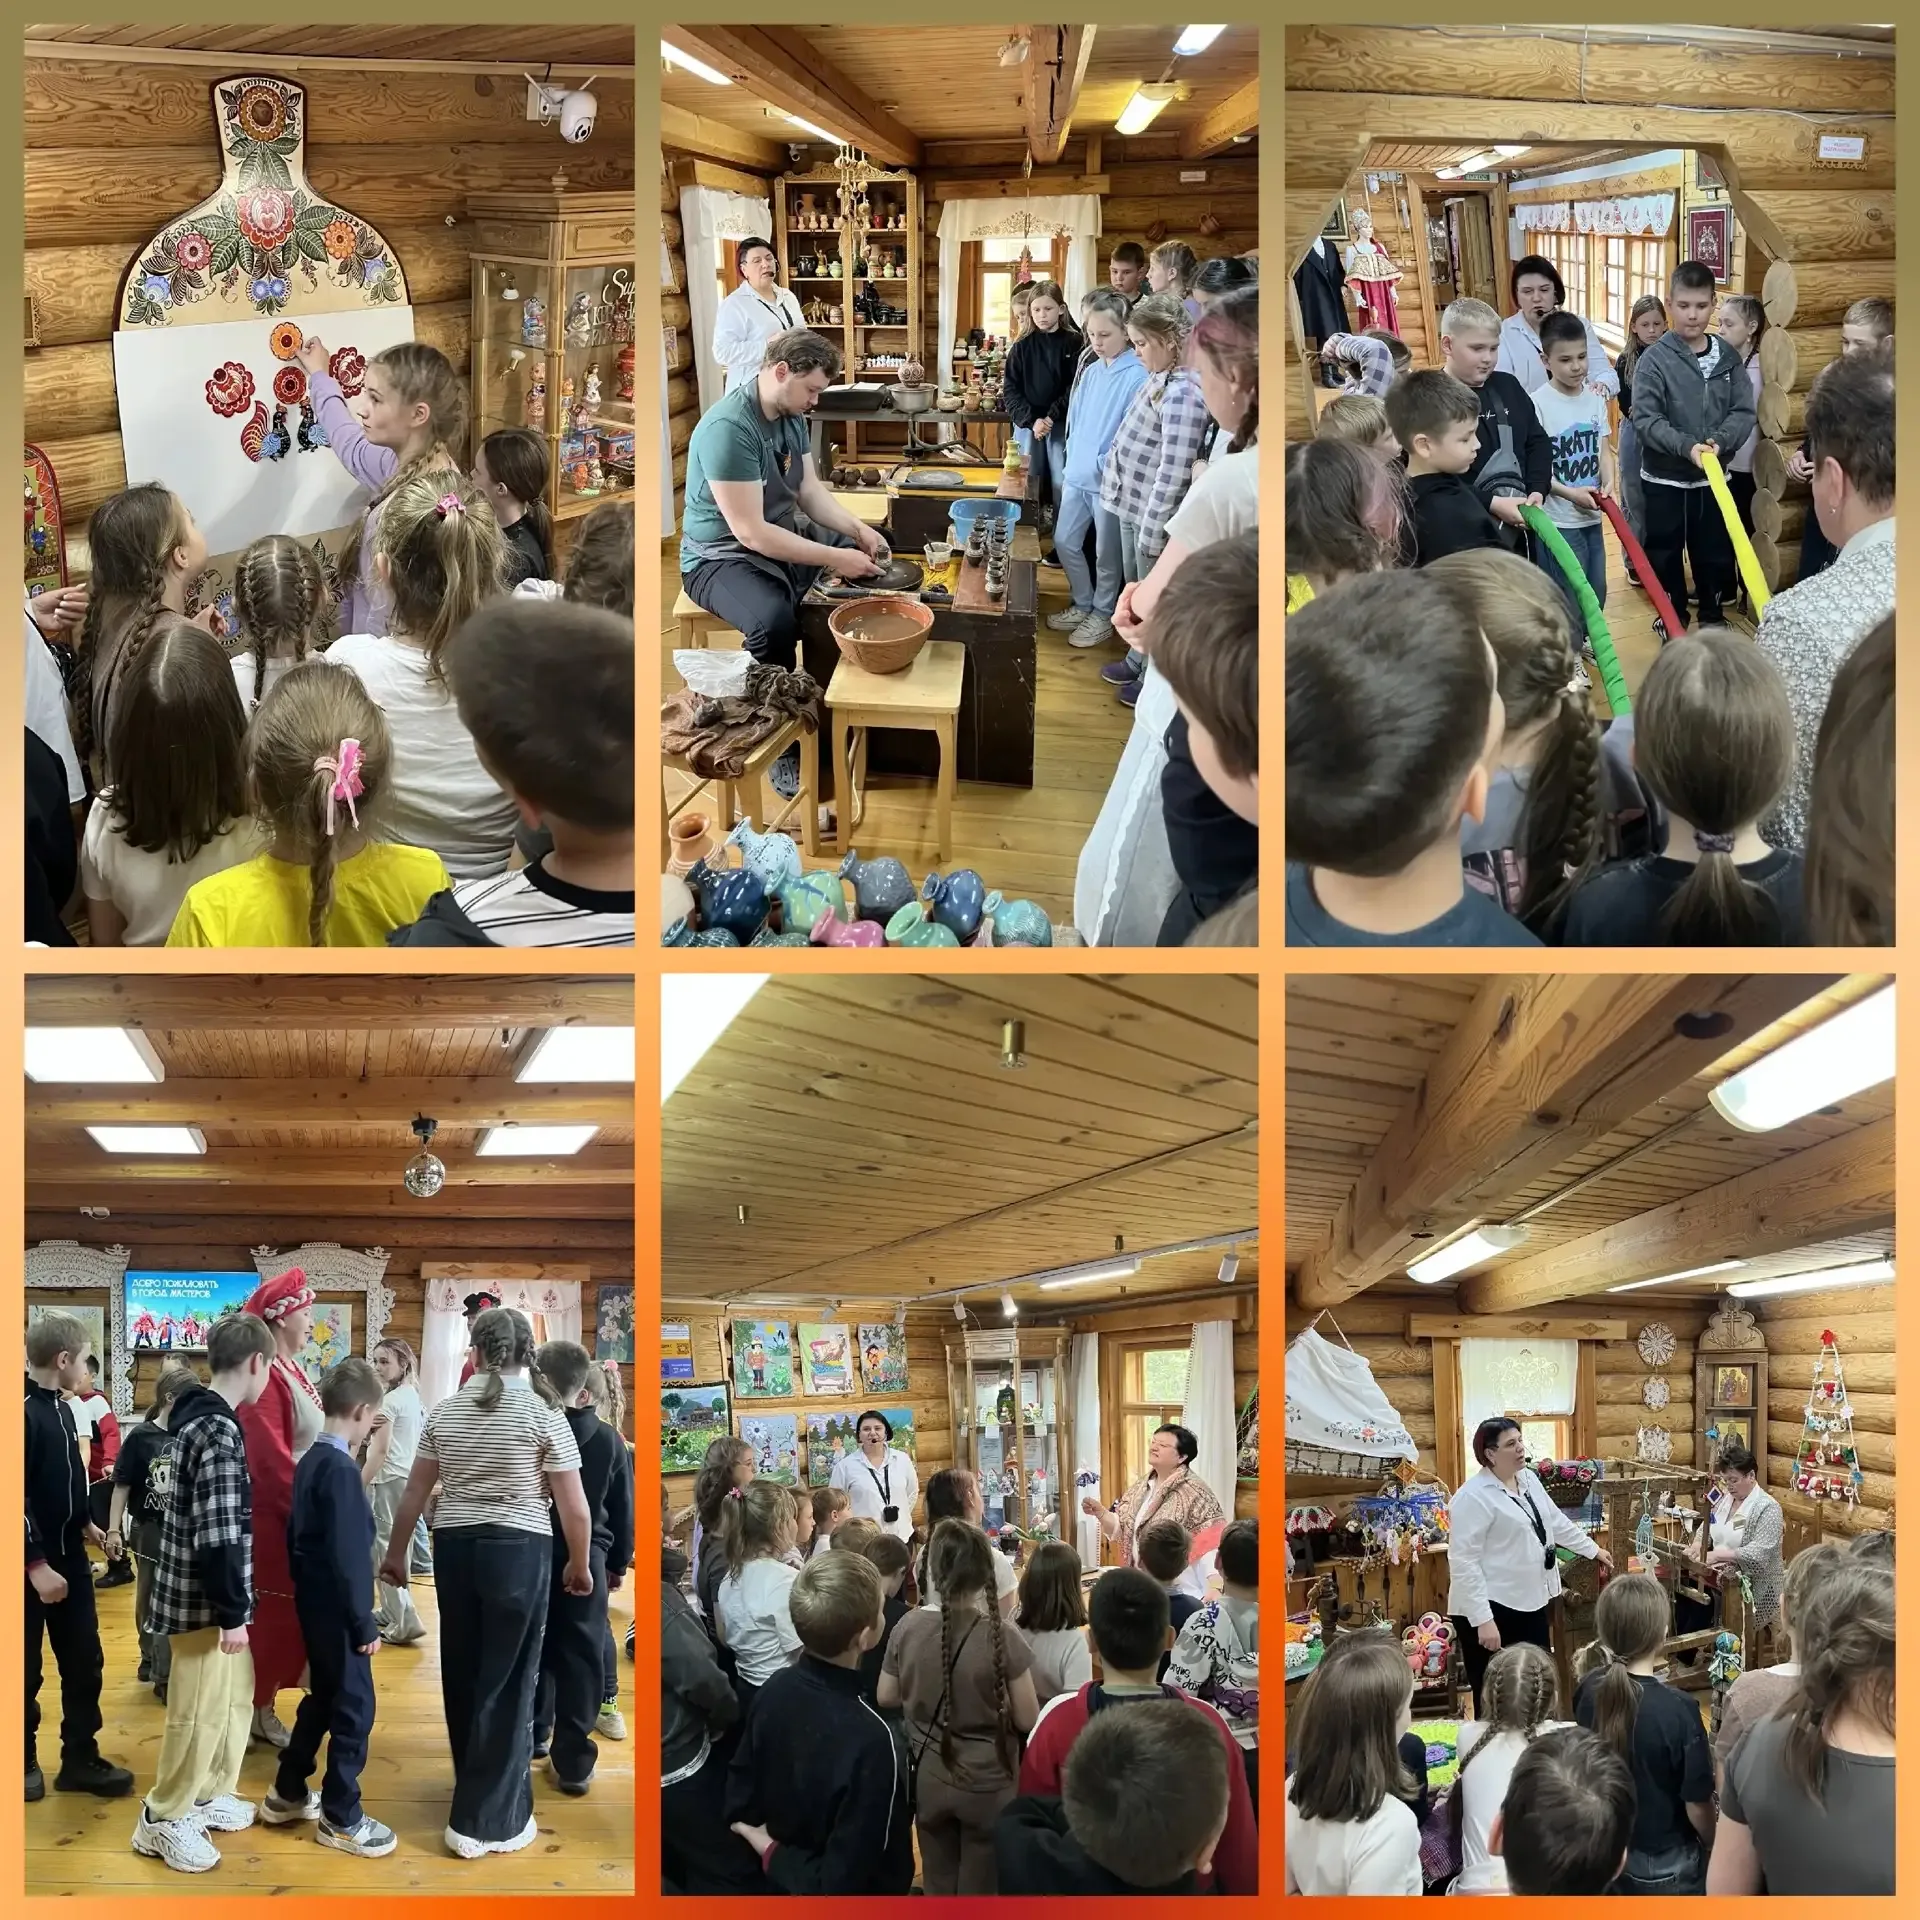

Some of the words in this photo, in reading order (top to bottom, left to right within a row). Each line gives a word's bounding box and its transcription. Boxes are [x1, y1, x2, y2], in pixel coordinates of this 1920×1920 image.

[1552, 429, 1600, 458] SKATE
[1552, 455, 1600, 482] MOOD
[132, 1279, 161, 1288] ДОБРО
[162, 1280, 219, 1289] ПОЖАЛОВАТЬ
[132, 1288, 137, 1297] В
[139, 1289, 168, 1298] ГОРОД
[170, 1289, 211, 1298] МАСТЕРОВ
